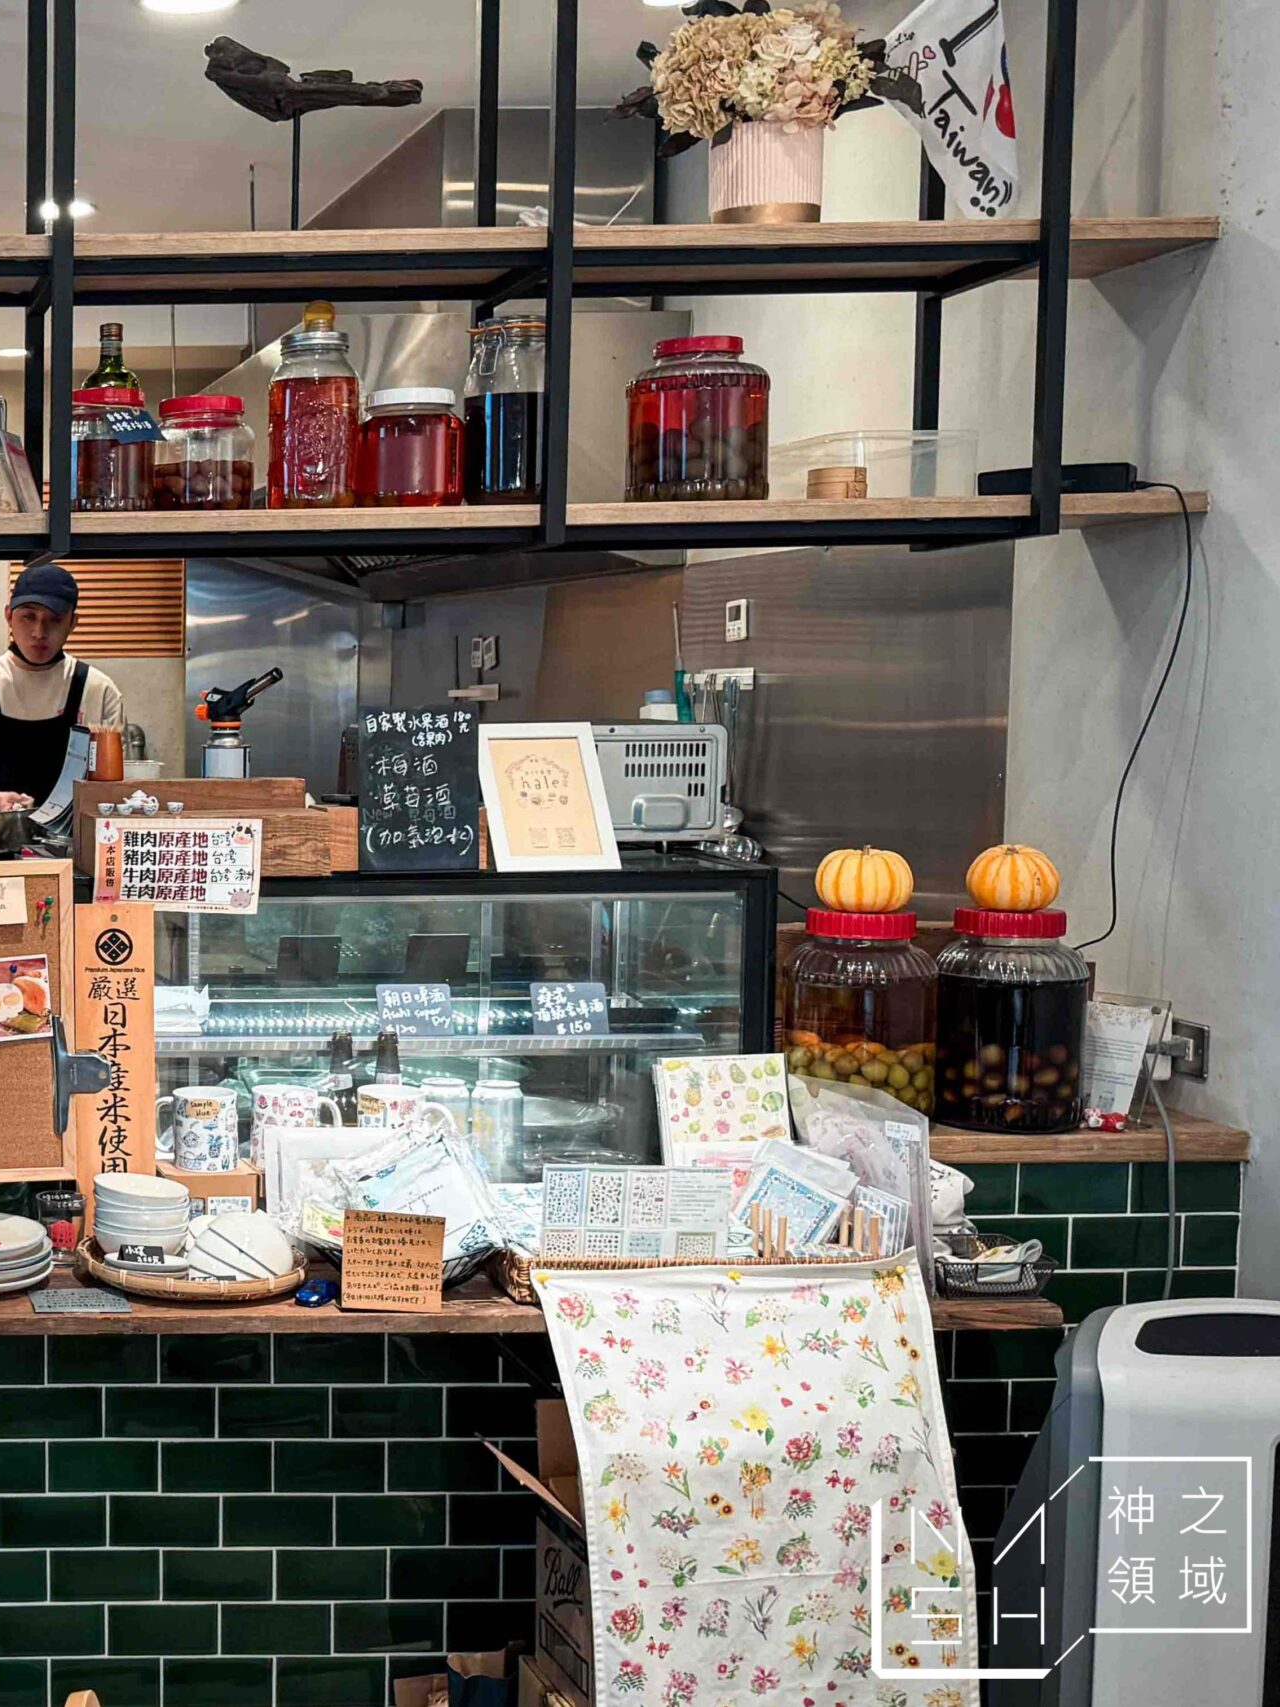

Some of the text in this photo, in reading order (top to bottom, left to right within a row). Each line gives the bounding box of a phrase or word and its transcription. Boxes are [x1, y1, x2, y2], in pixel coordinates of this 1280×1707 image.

[366, 711, 471, 734] 自家製水果酒 180
[123, 831, 208, 848] 雞肉原產地
[123, 849, 208, 866] 豬肉原產地
[122, 867, 207, 884] 牛肉原產地
[121, 884, 206, 901] 羊肉原產地
[88, 976, 141, 1001] 厳選
[382, 986, 446, 1008] 朝日啤酒
